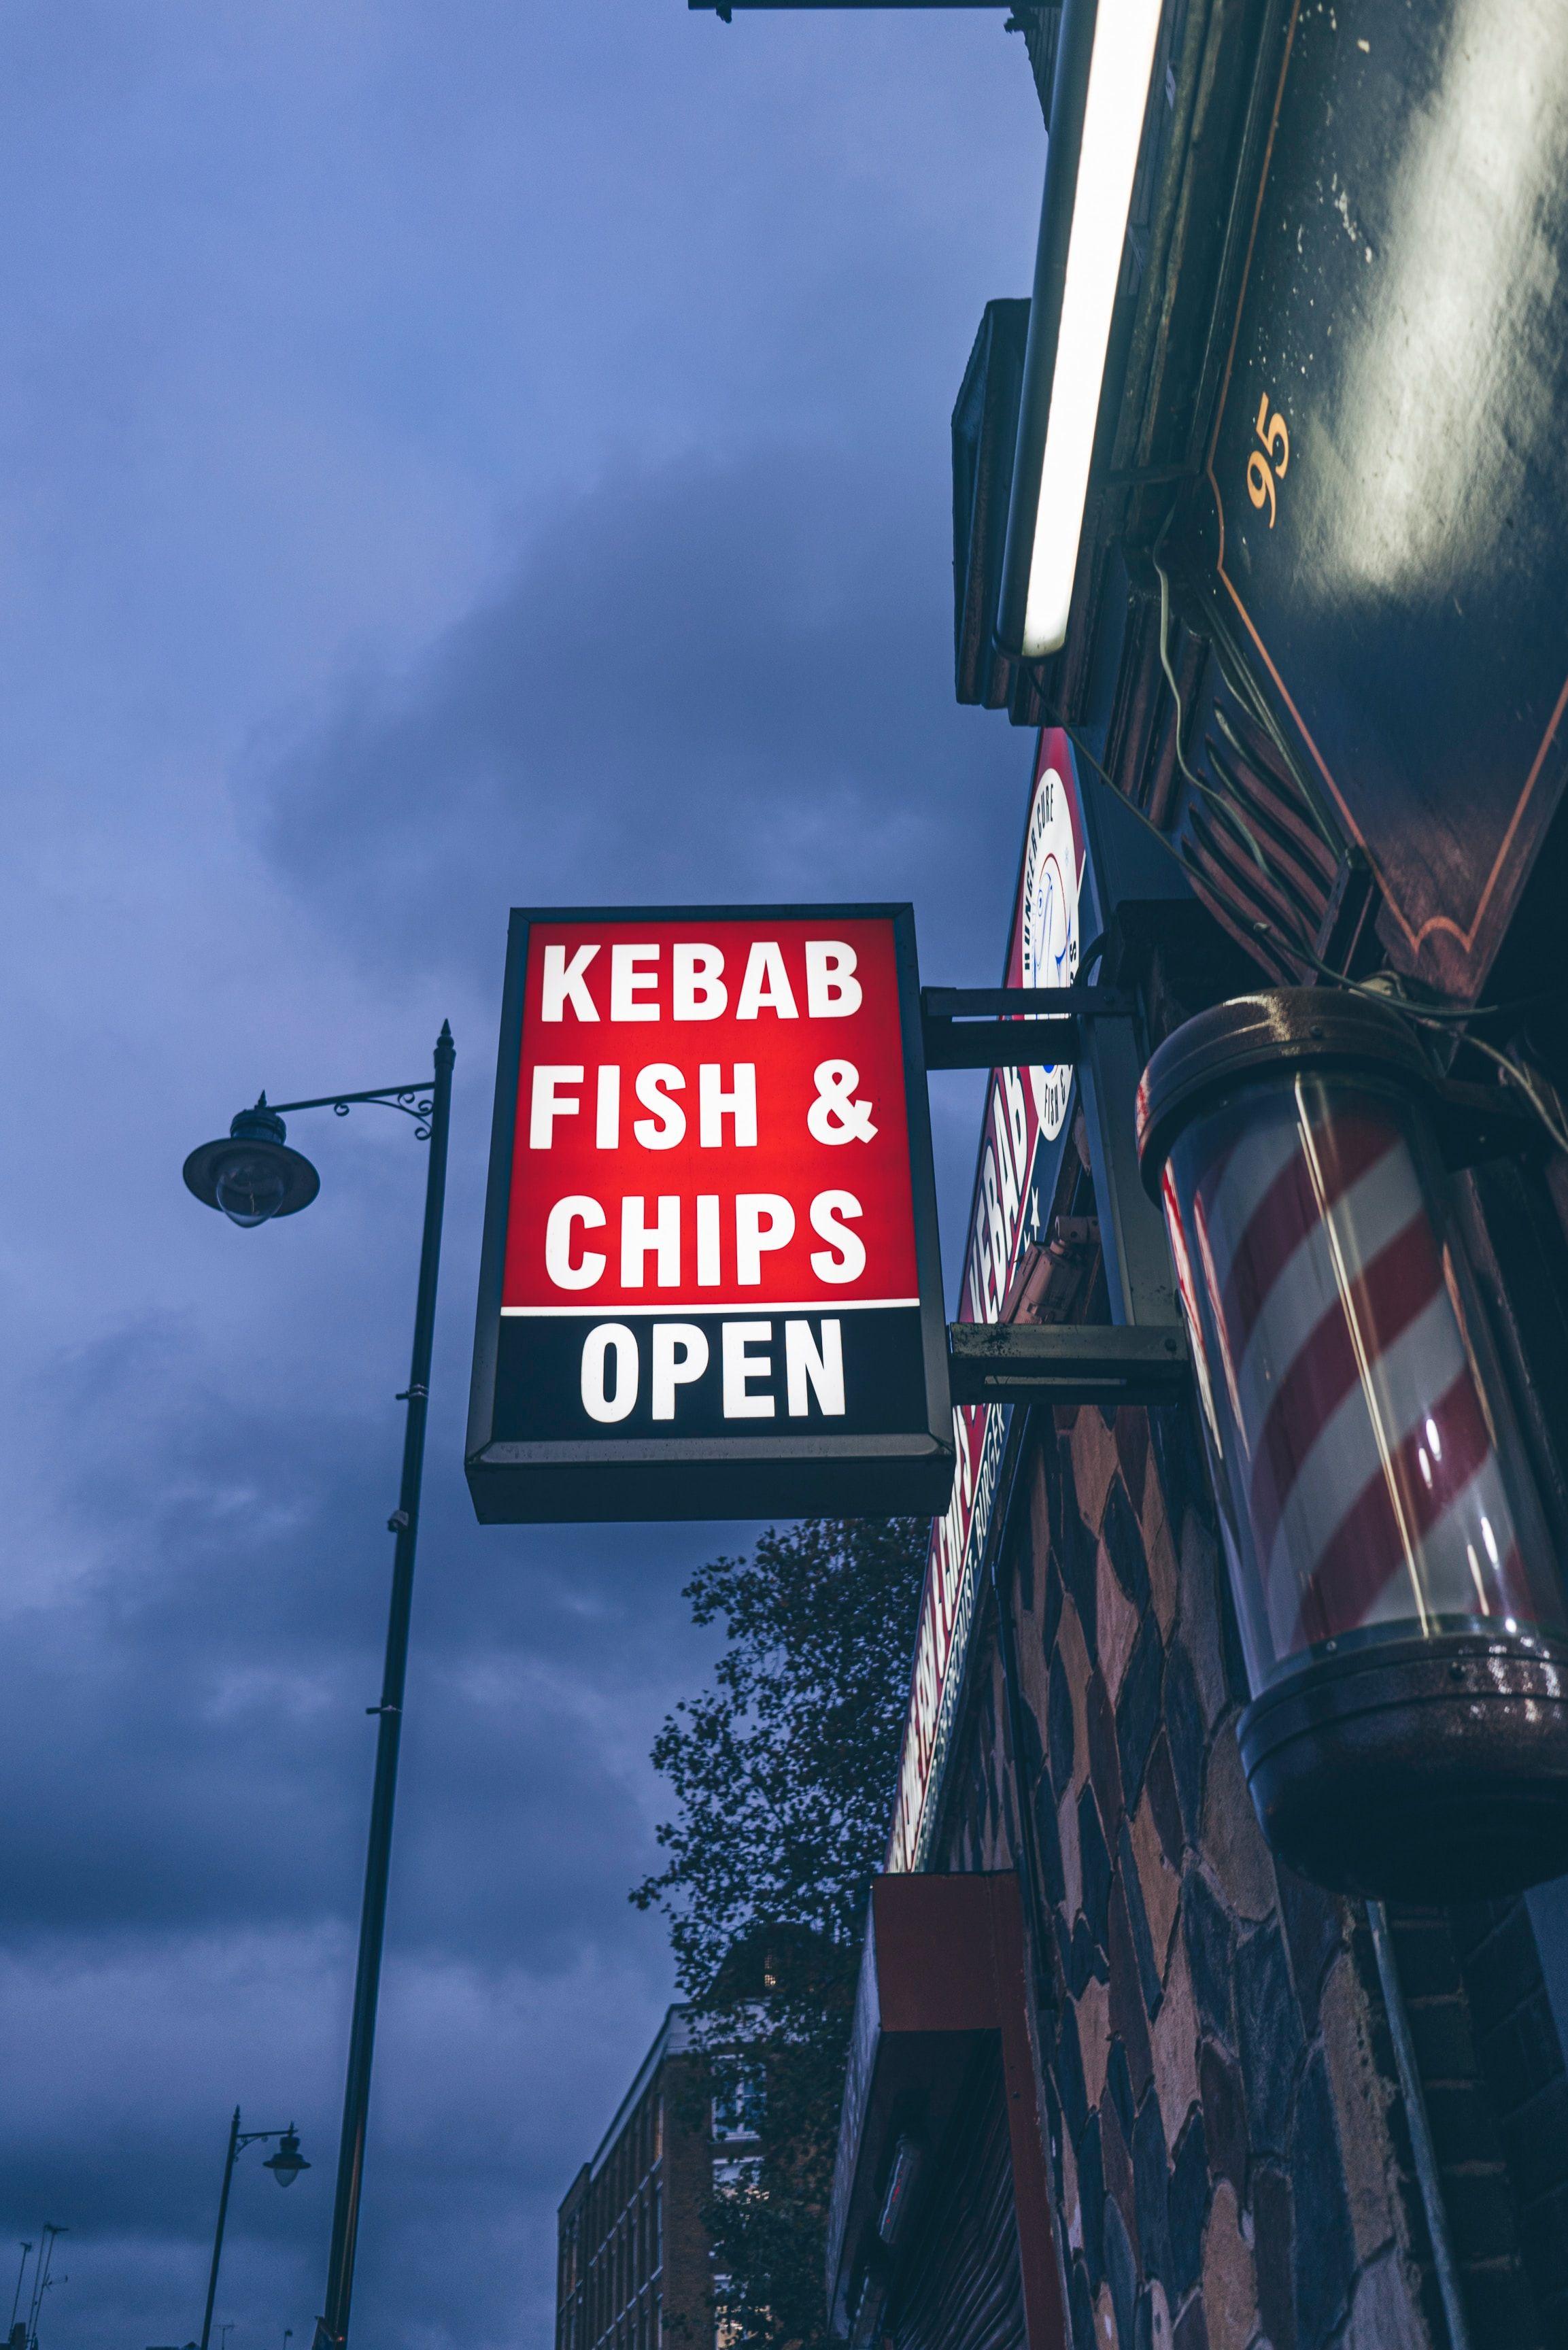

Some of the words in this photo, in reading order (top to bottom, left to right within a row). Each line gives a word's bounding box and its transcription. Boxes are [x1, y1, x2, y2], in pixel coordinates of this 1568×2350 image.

[1246, 391, 1289, 529] 95
[541, 940, 864, 1022] KEBAB
[530, 1062, 758, 1151] FISH
[806, 1058, 879, 1146] &
[1044, 1083, 1059, 1127] FISH
[545, 1189, 868, 1291] CHIPS
[580, 1318, 847, 1423] OPEN
